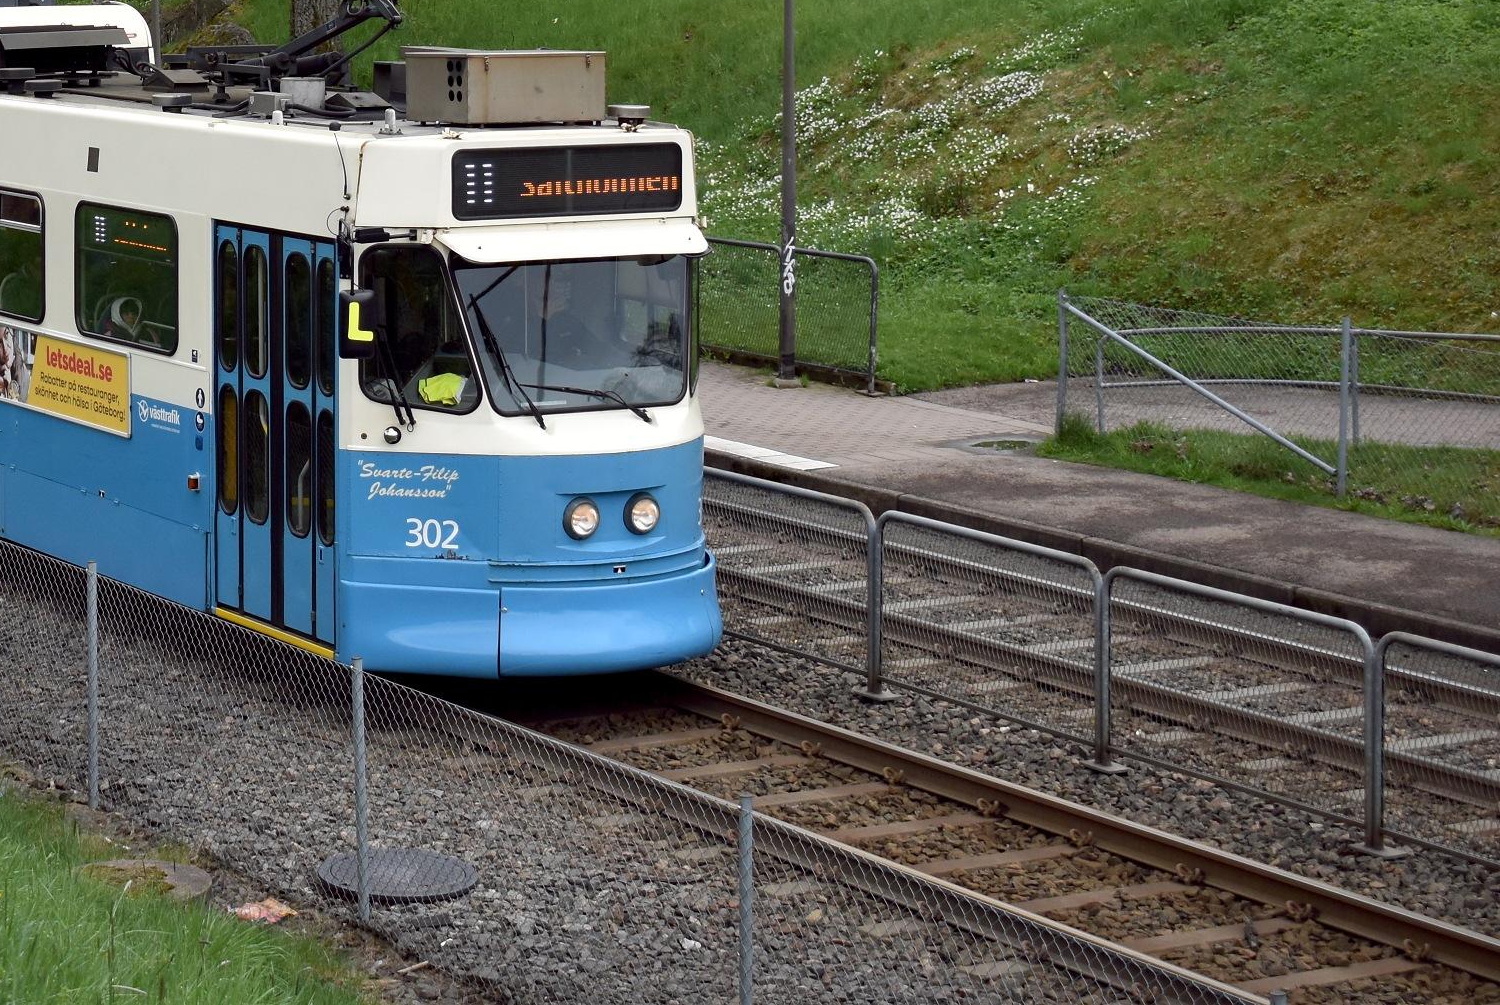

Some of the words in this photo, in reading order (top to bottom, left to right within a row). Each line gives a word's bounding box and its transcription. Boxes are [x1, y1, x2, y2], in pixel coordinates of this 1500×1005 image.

[45, 345, 113, 383] letsdeal.se
[34, 386, 59, 402] skönhet
[59, 393, 72, 405] och
[72, 397, 90, 410] hälsa
[93, 401, 126, 423] Göteborg!
[40, 371, 67, 388] Rabatter
[68, 378, 76, 392] på
[77, 384, 120, 406] restauranger,
[149, 405, 181, 426] västtrafik
[367, 481, 452, 500] Johansson"
[405, 517, 459, 549] 302
